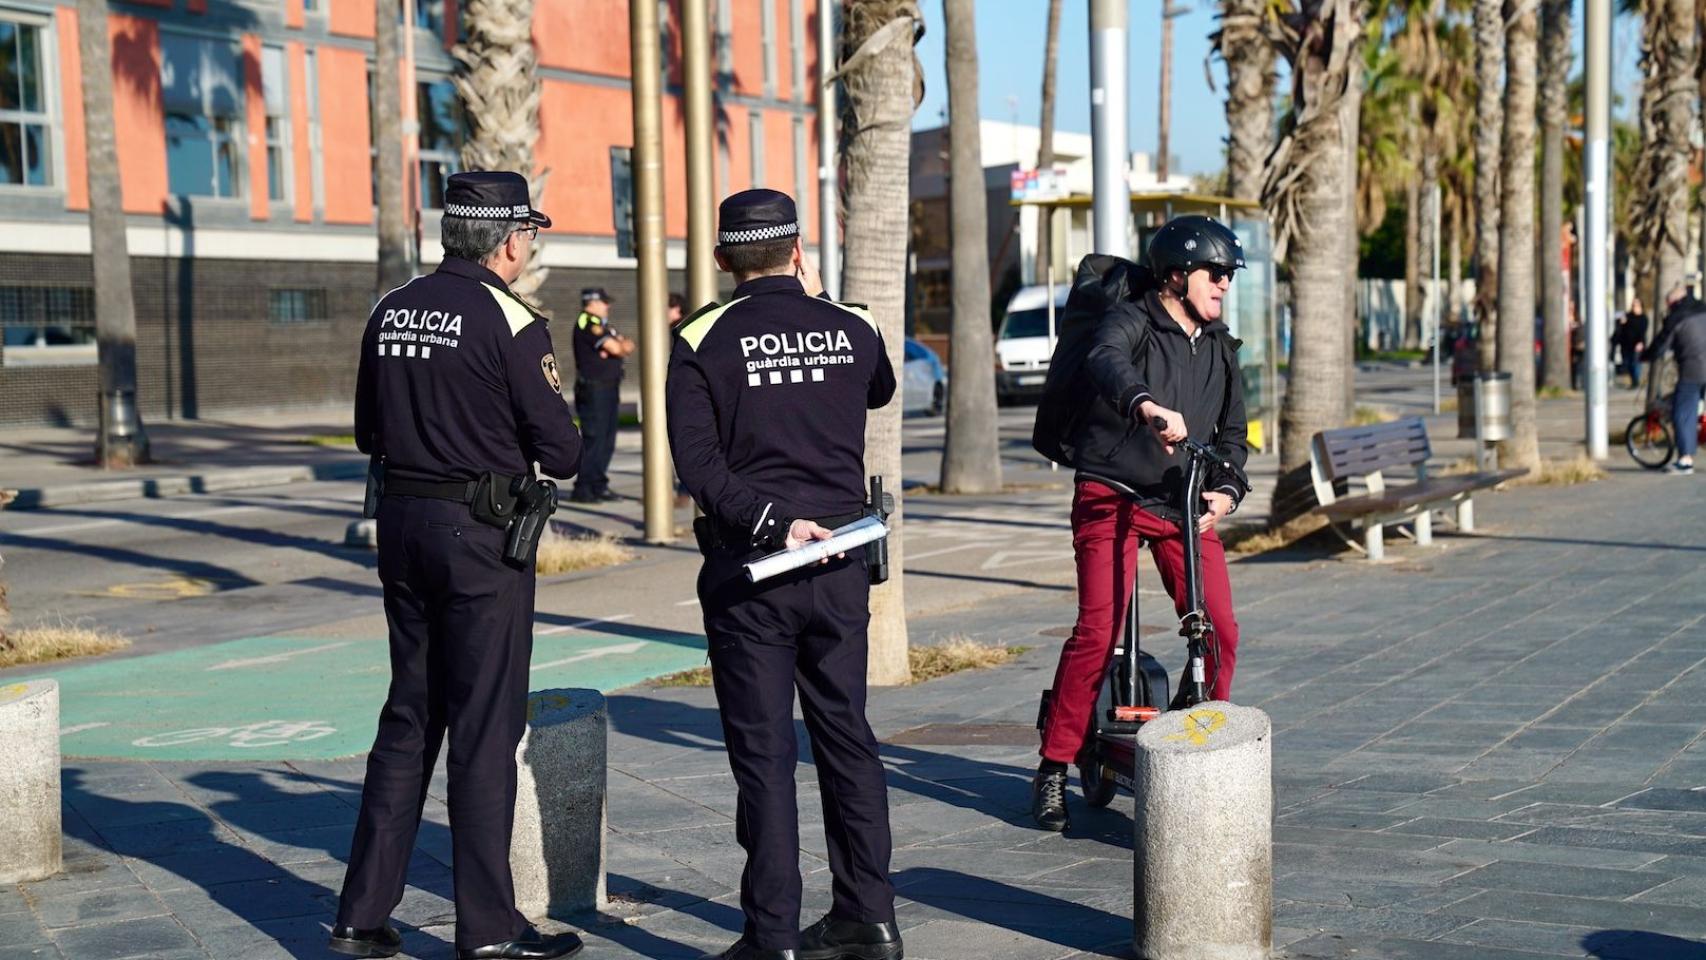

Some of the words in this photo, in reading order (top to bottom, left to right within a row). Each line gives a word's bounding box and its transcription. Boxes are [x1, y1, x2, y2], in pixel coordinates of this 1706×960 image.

[380, 308, 462, 336] POLICIA
[378, 330, 417, 343] guàrdia
[419, 333, 459, 348] urbana
[740, 329, 853, 358] POLICIA
[746, 355, 801, 372] guàrdia
[804, 354, 854, 366] urbana
